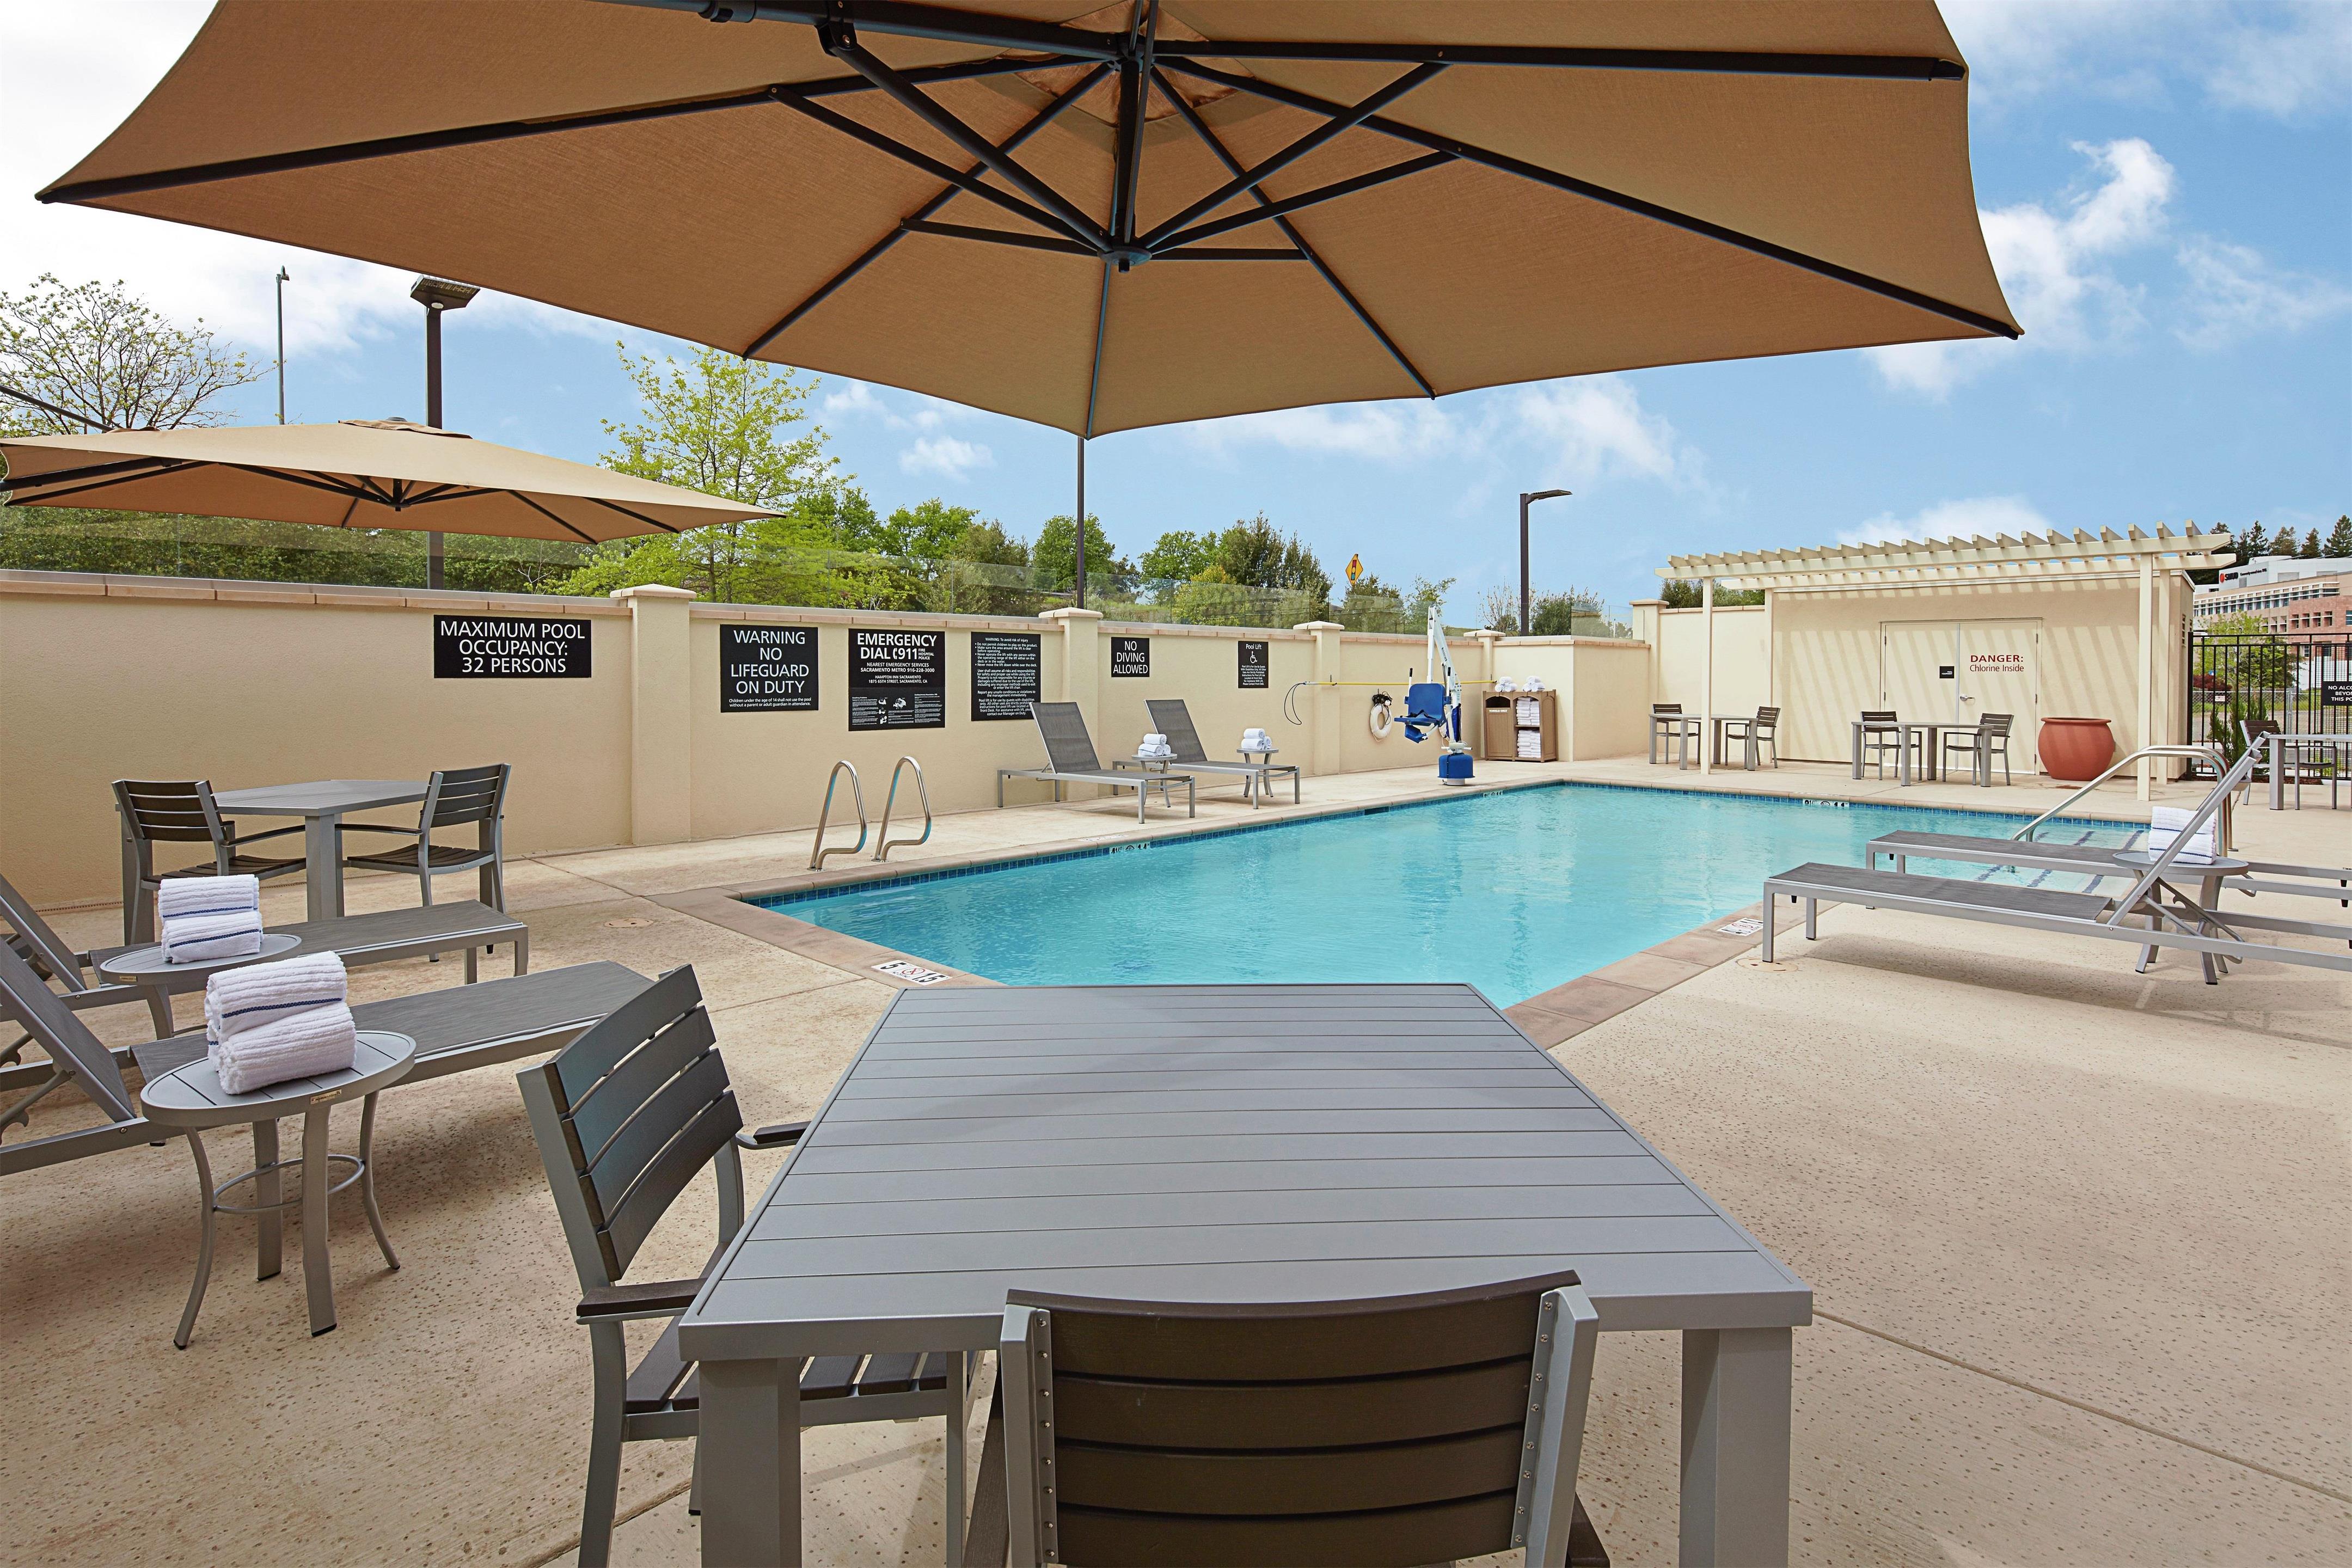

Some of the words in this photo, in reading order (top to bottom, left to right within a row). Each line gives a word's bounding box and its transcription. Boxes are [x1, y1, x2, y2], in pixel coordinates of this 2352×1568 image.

[441, 621, 535, 638] MAXIMUM
[542, 623, 585, 639] POOL
[733, 630, 805, 644] WARNING
[857, 633, 937, 646] EMERGENCY
[460, 640, 567, 656] OCCUPANCY:
[1125, 641, 1137, 651] NO
[760, 648, 782, 660] NO
[861, 647, 891, 659] DIAL
[898, 648, 917, 659] 911
[1117, 652, 1145, 663] DIVING
[462, 657, 483, 672] 32
[492, 657, 566, 672] PERSONS
[731, 664, 809, 677] LIFEGUARD
[1113, 664, 1148, 673] ALLOWED
[736, 681, 759, 694] ON
[765, 681, 805, 693] DUTY
